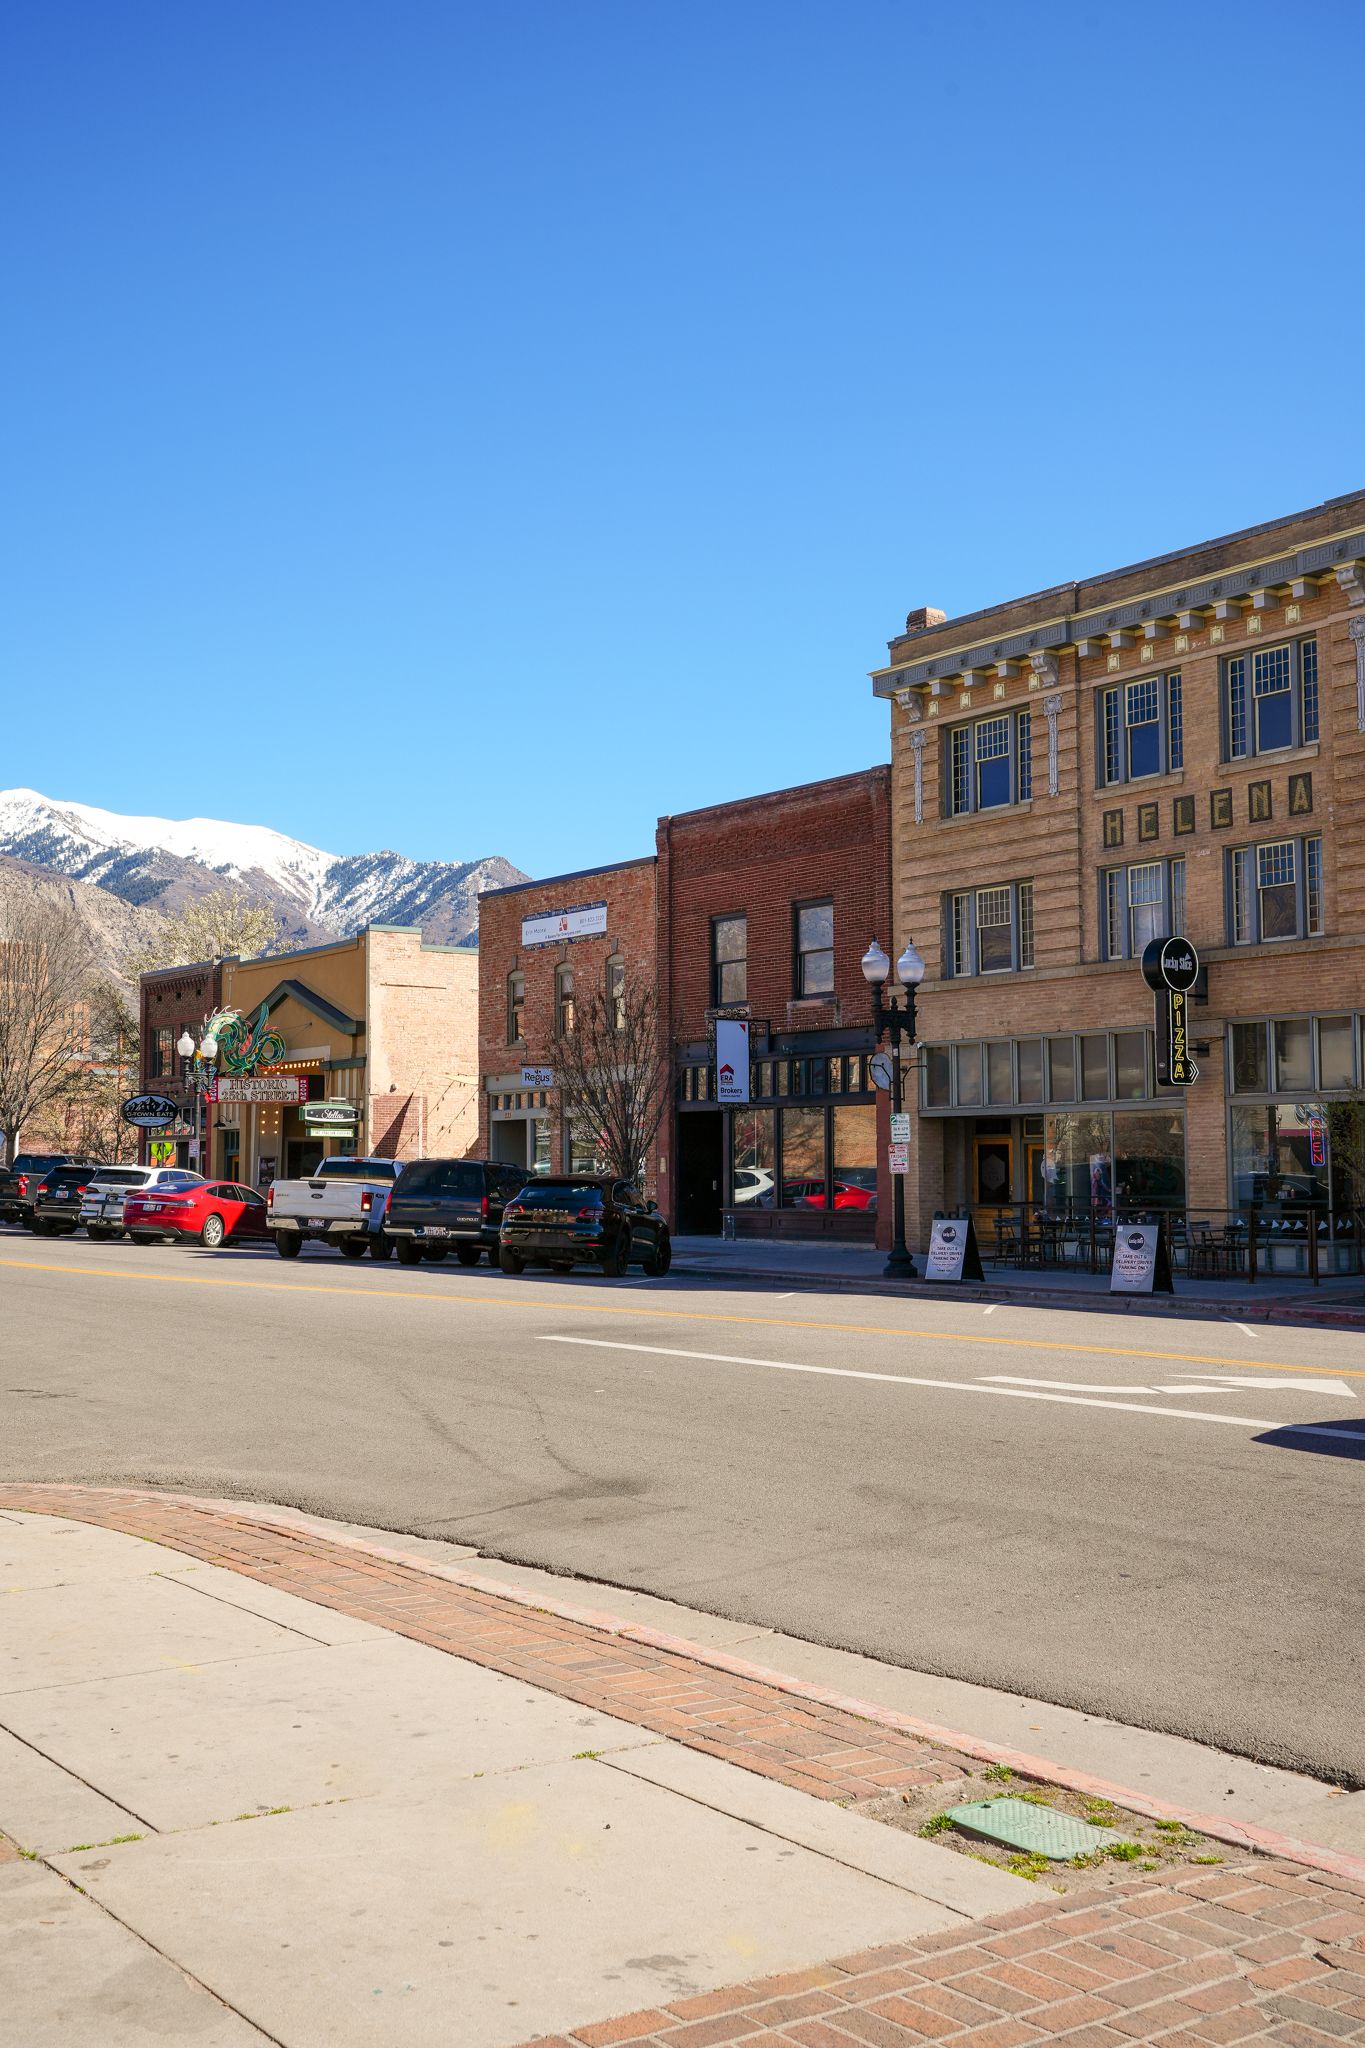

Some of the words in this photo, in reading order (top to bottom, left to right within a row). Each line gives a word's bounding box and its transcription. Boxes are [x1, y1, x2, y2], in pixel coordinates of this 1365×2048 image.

[1106, 777, 1310, 846] HELENA
[1163, 956, 1179, 972] Lucky
[1180, 957, 1193, 971] Slice
[1173, 994, 1185, 1079] PIZZA
[229, 1079, 288, 1090] HISTORIC
[524, 1072, 550, 1086] Regus
[222, 1090, 247, 1101] 25th
[250, 1090, 298, 1101] STREET
[1311, 1119, 1323, 1164] OPEN
